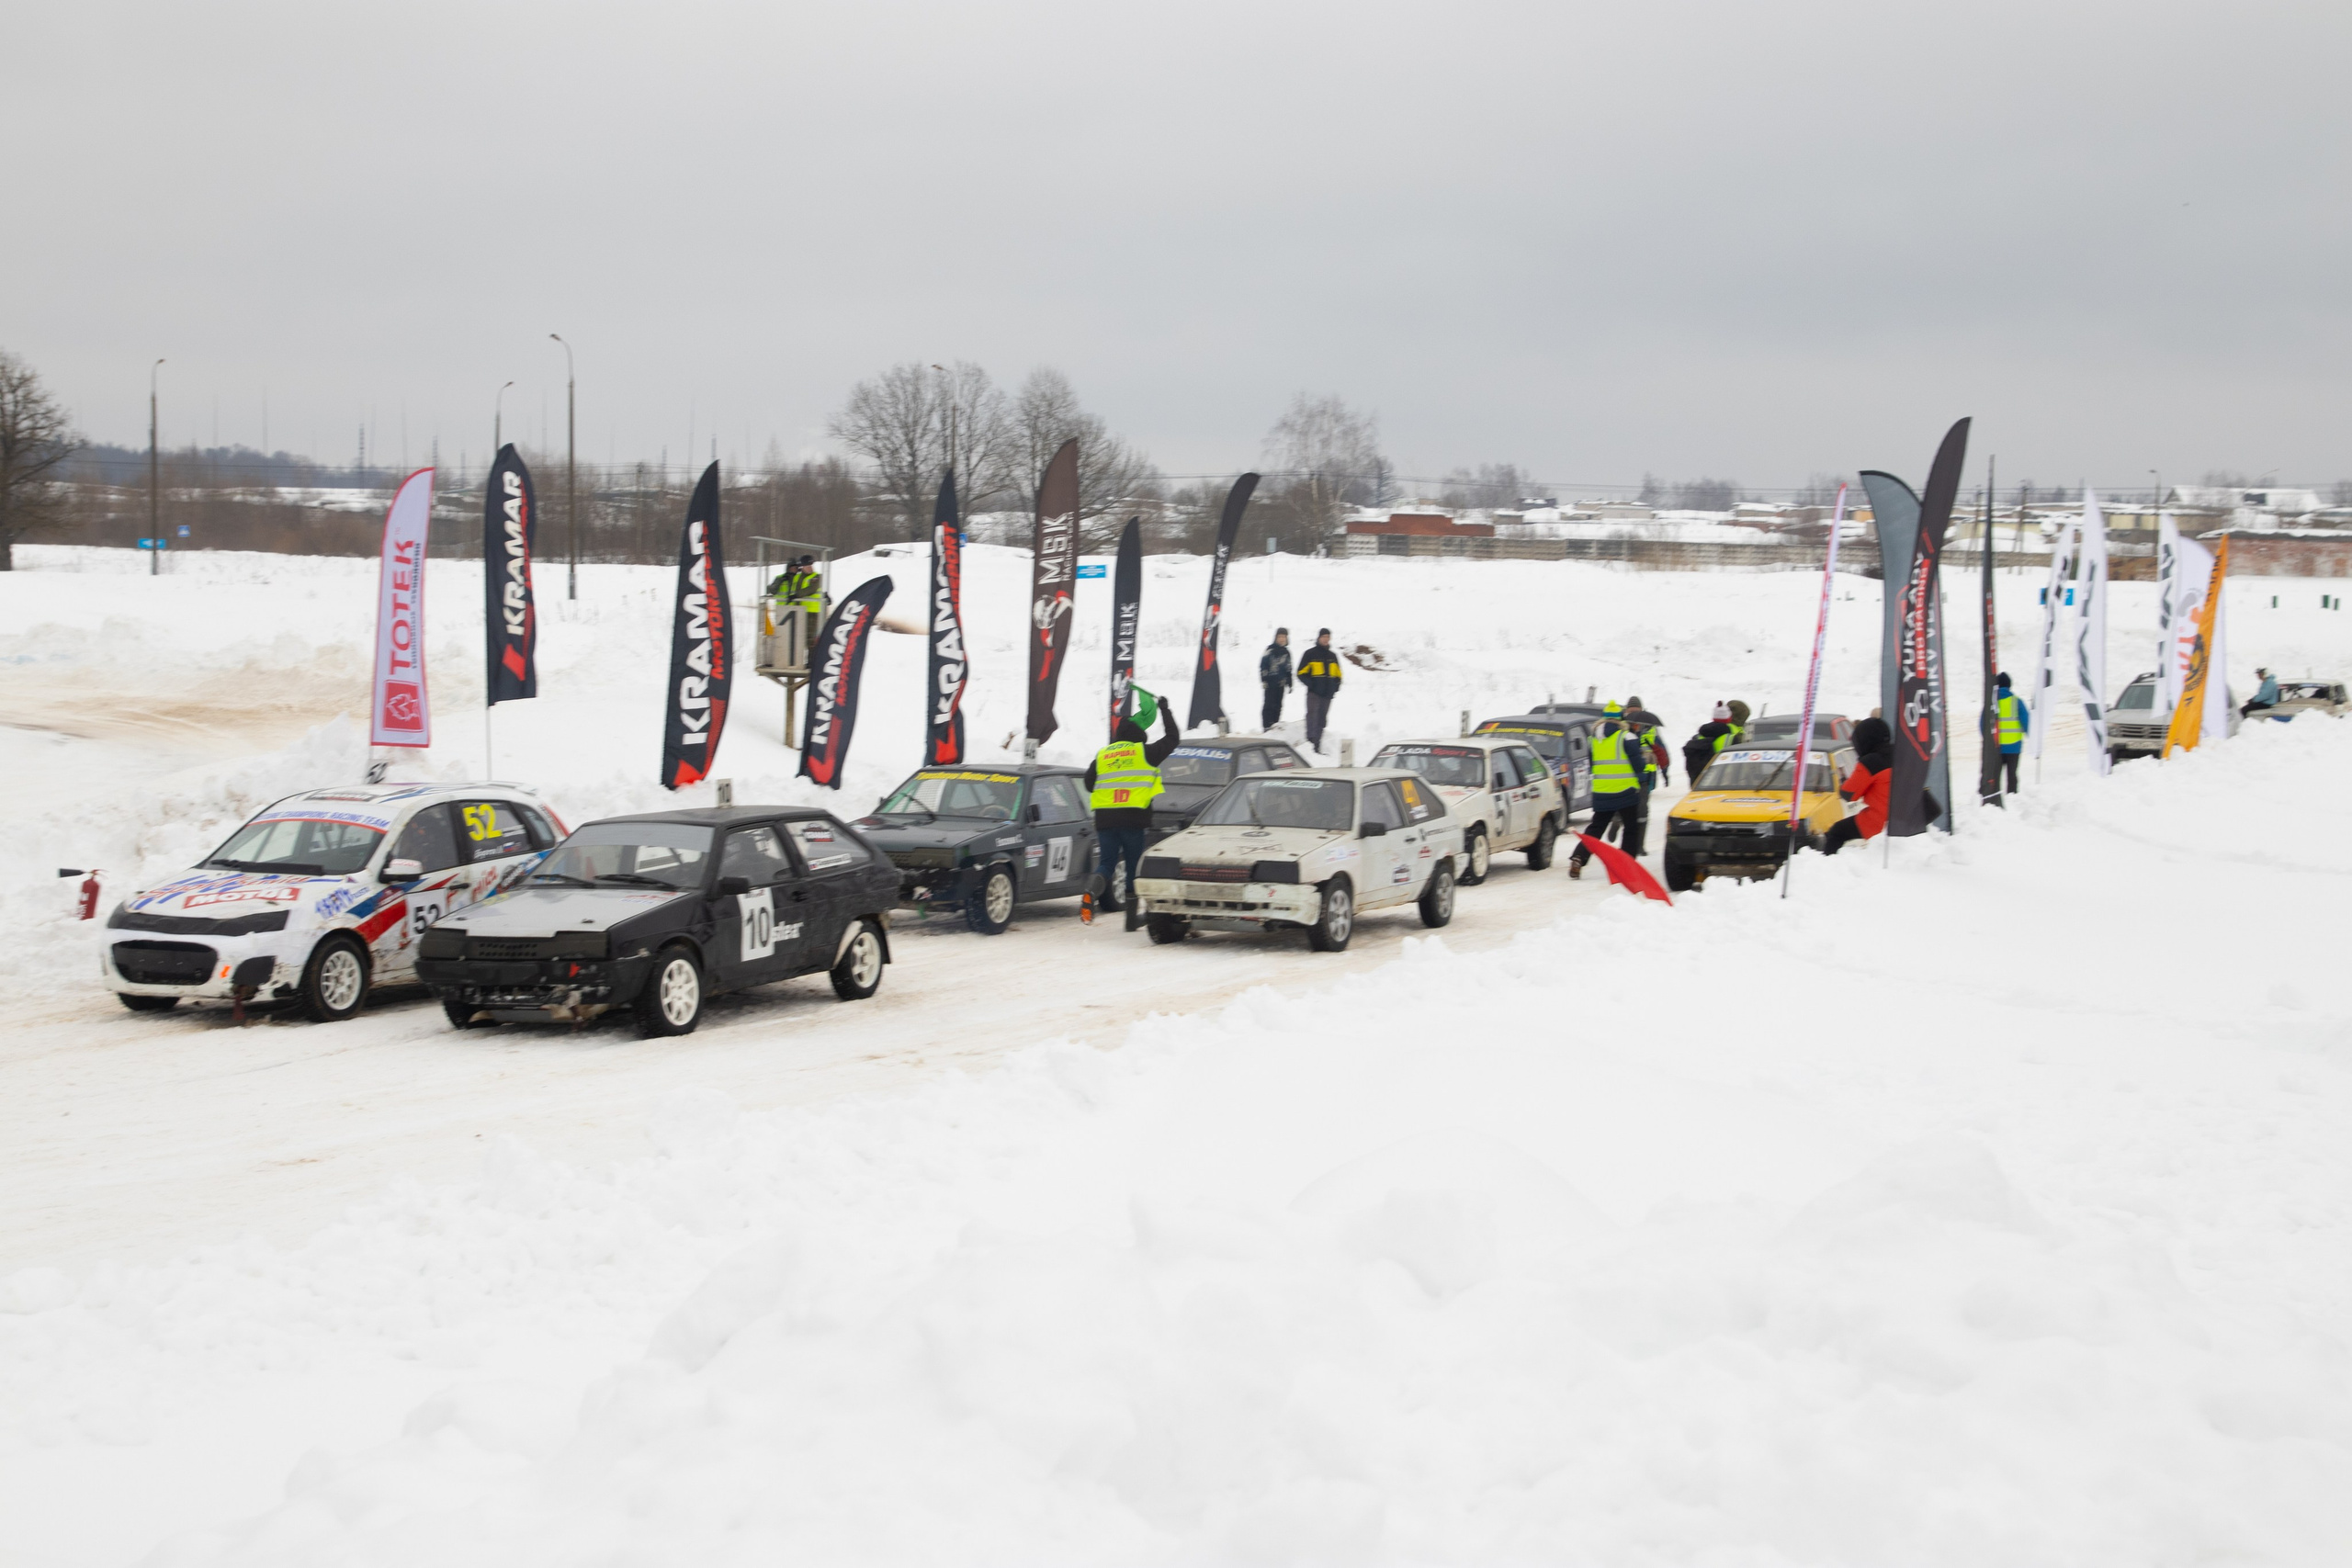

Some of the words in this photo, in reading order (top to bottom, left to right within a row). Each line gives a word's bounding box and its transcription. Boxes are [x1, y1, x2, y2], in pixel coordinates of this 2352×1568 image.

[503, 470, 526, 636] KRAMAR
[390, 539, 415, 674] TOTEK
[680, 520, 712, 745] KRAMAR
[778, 610, 797, 667] 1
[810, 600, 865, 745] KRAMAR
[1170, 748, 1233, 761] ОВИЦЫ
[462, 804, 502, 841] 52
[187, 887, 297, 908] MOTUL
[745, 906, 770, 949] 10
